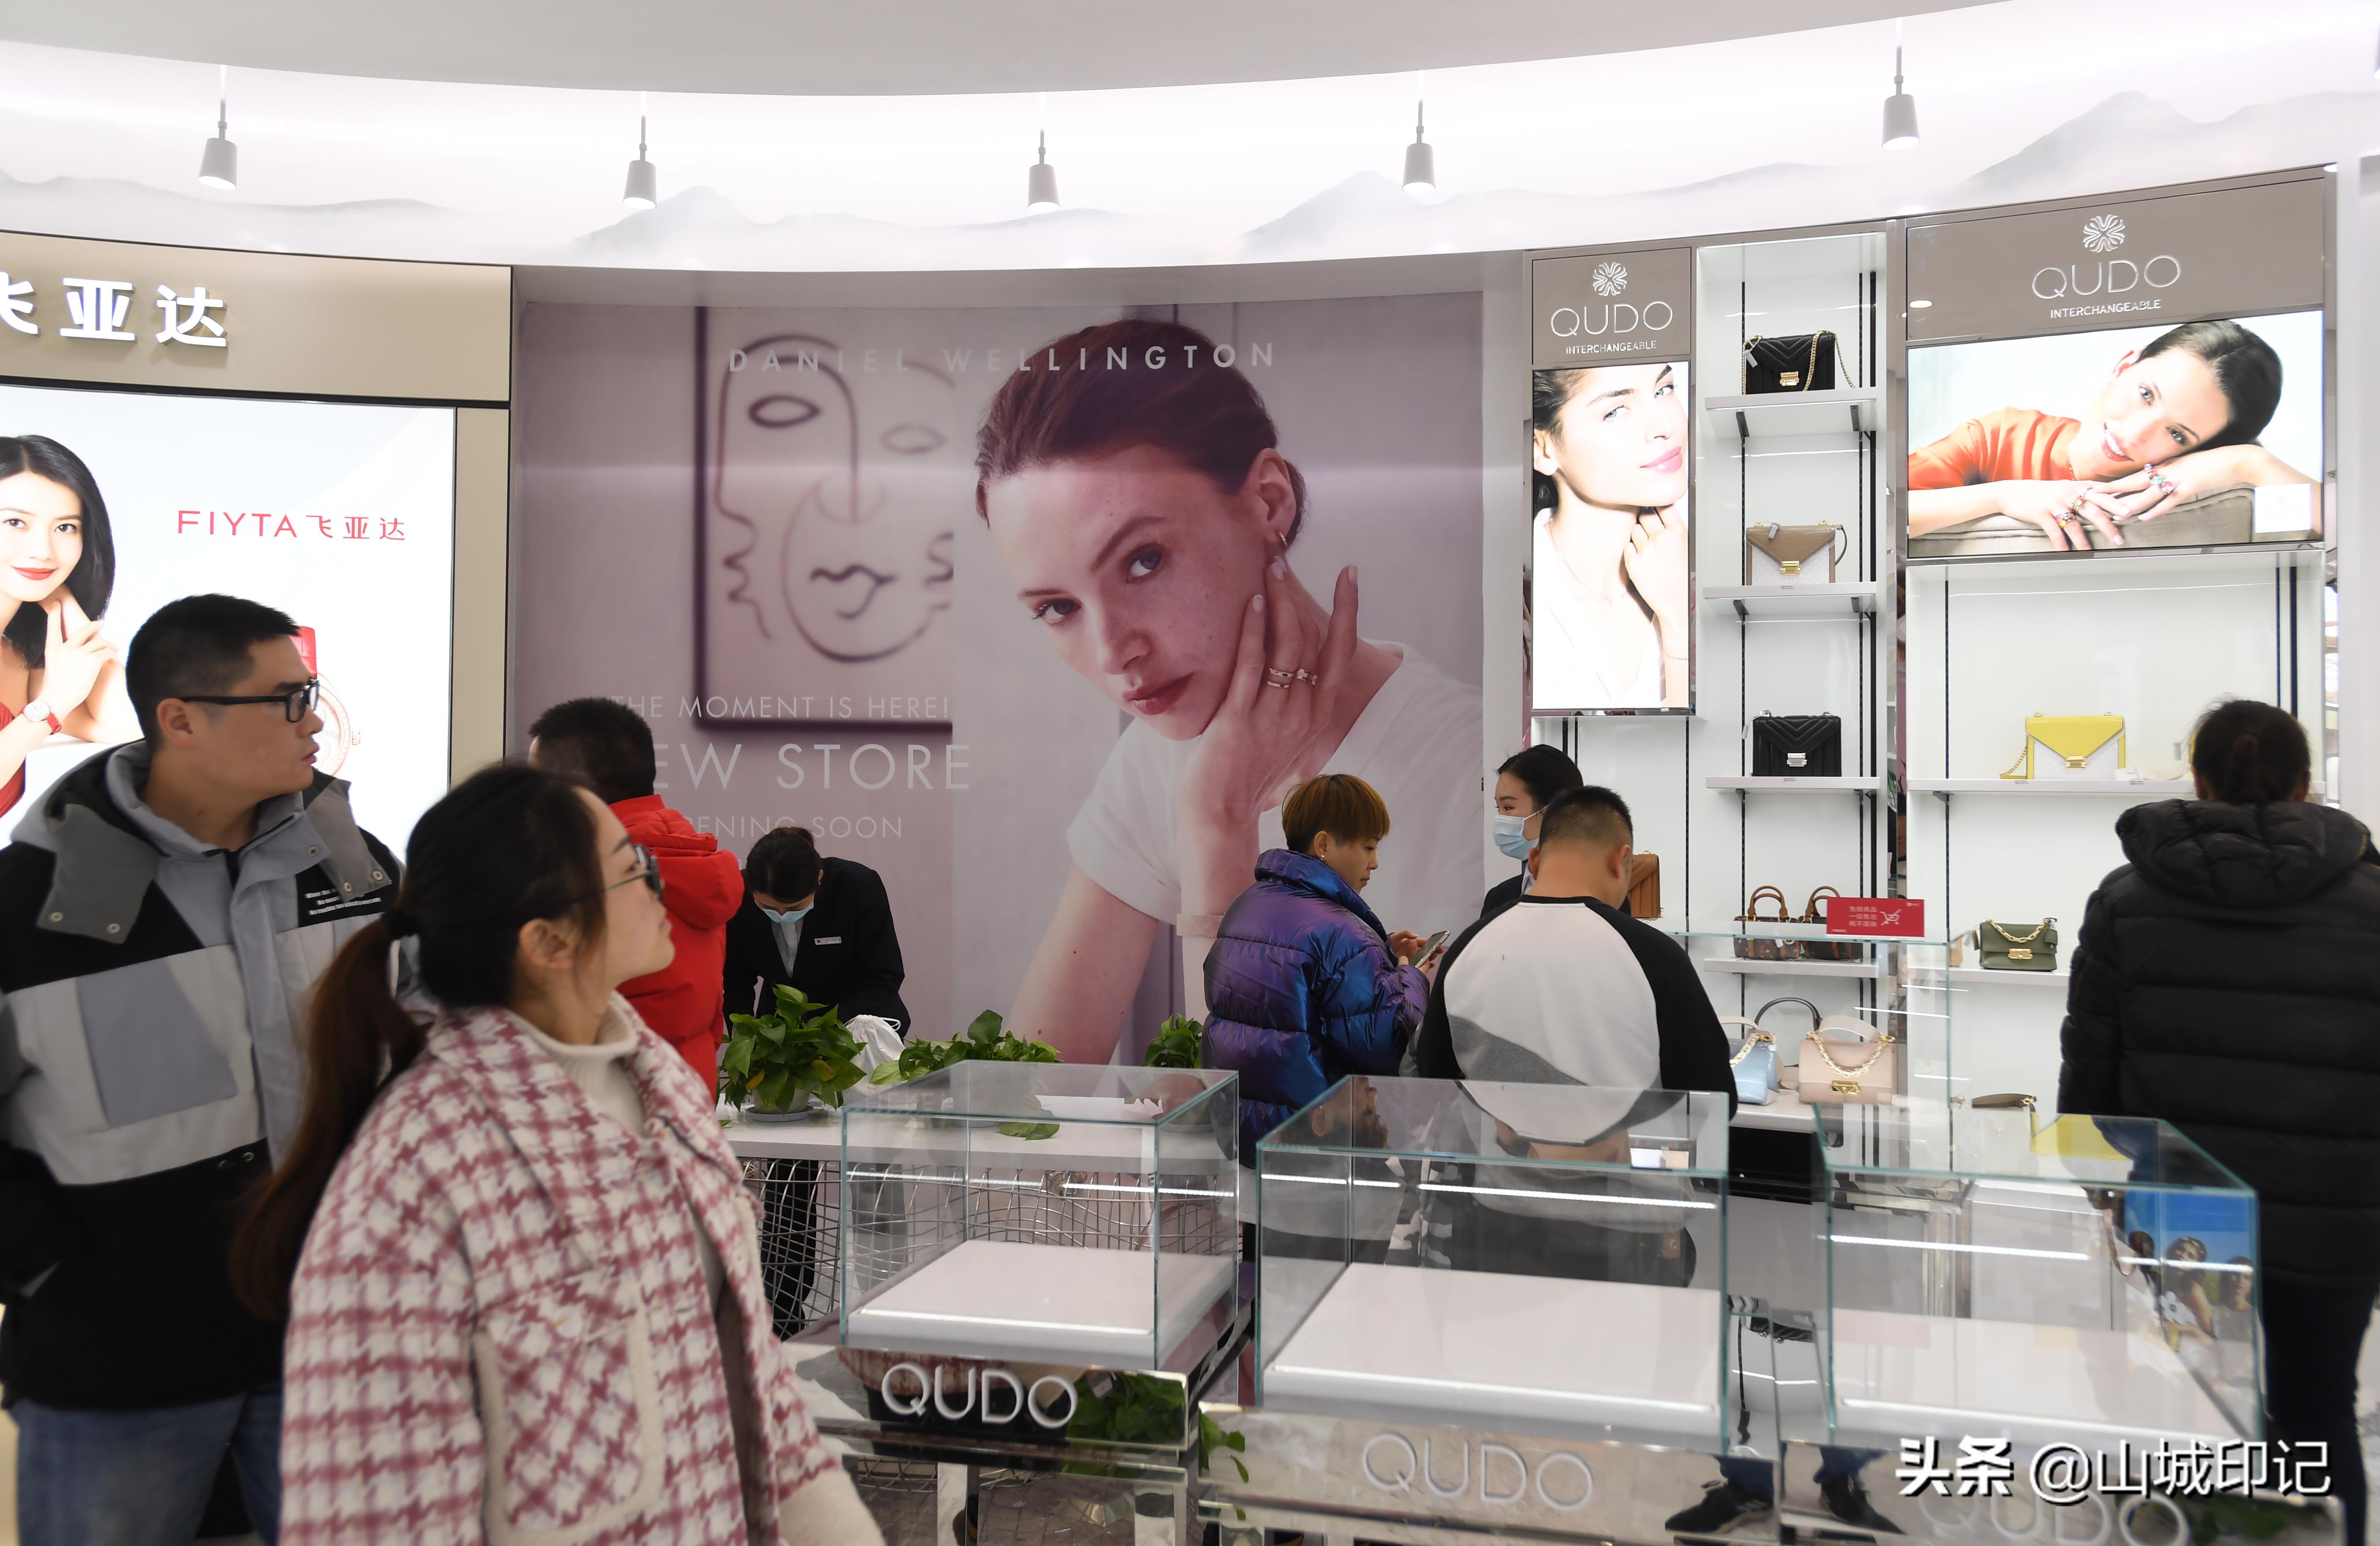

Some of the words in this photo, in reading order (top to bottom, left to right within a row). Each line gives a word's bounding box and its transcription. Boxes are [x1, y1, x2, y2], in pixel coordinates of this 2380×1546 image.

[2031, 254, 2181, 299] QUDO
[1550, 300, 1673, 337] QUDO
[2050, 299, 2161, 319] INTERCHANGEABLE
[729, 349, 908, 372] DANIEL
[942, 343, 1273, 372] WELLINGTON
[1566, 340, 1657, 355] INTERCHANGEABLE
[178, 509, 298, 538] FIYTA
[306, 514, 406, 541] 飞亚达
[679, 696, 814, 718] MOMENT
[829, 696, 853, 718] IS
[868, 696, 948, 718] HERE!
[653, 742, 742, 790] EW
[776, 743, 970, 790] STORE
[813, 816, 902, 838] SOON
[881, 1362, 1078, 1429] QUDO
[1361, 1431, 1594, 1512] QUDO
